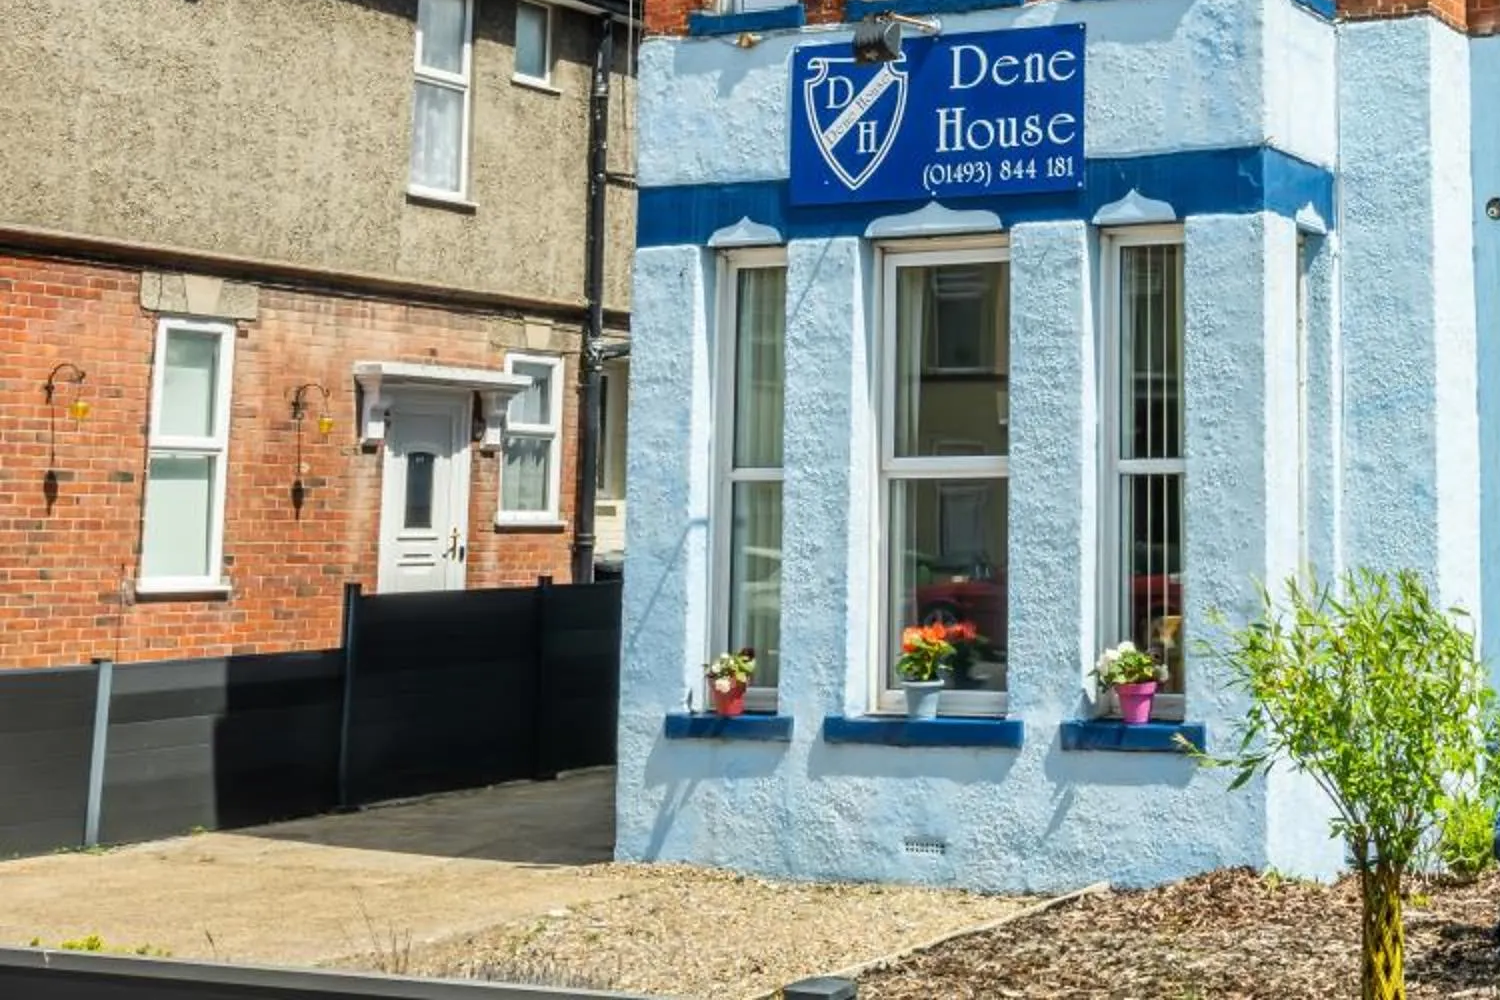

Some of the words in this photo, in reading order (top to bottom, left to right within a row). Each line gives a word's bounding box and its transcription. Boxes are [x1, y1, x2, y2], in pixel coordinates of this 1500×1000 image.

[949, 44, 1076, 89] Dene
[825, 75, 855, 109] D
[856, 120, 879, 153] H
[935, 107, 1075, 153] House
[923, 161, 992, 190] (01493)
[999, 158, 1037, 181] 844
[1046, 156, 1073, 177] 181
